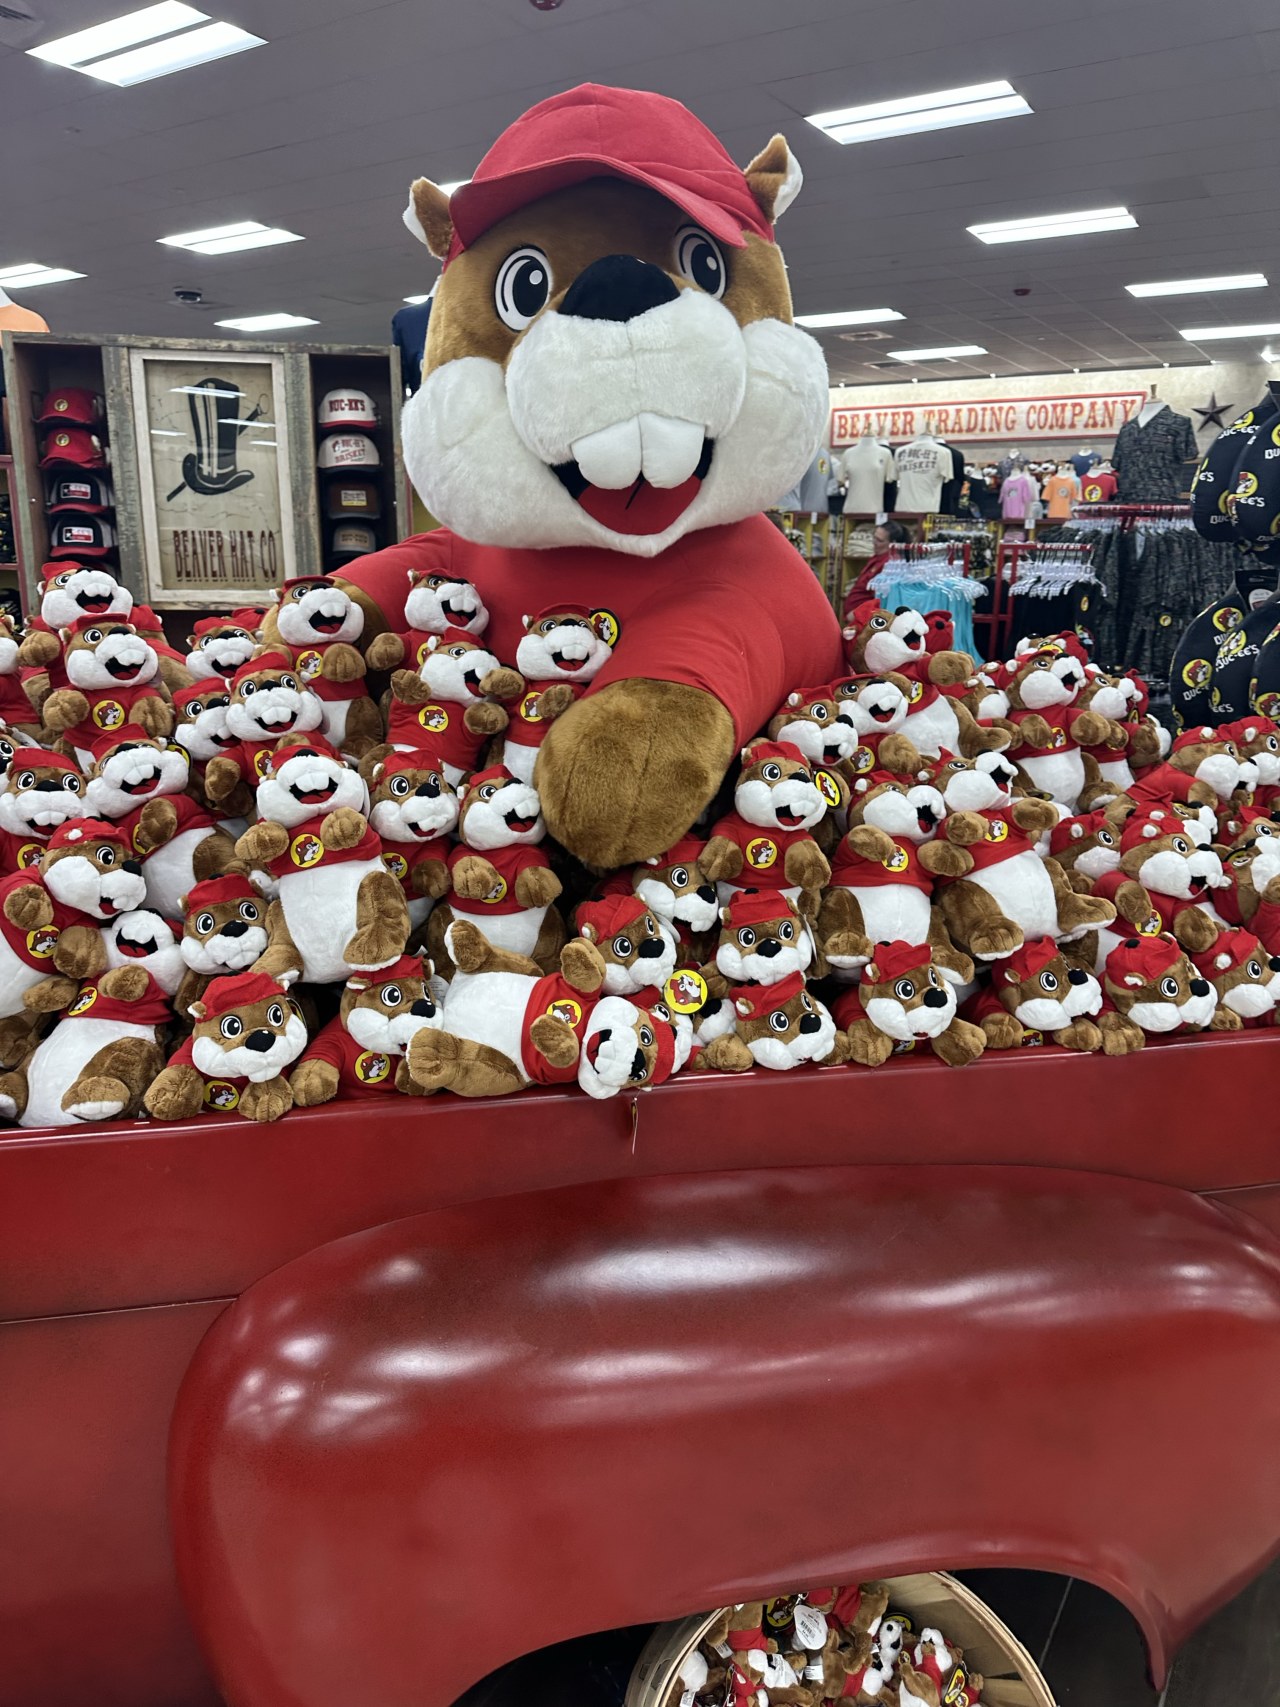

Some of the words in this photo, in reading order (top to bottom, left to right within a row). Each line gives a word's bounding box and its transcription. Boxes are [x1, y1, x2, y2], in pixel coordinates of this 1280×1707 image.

[836, 410, 915, 439] BEAVER
[923, 404, 1018, 434] TRADING
[1026, 399, 1137, 430] COMPANY
[1236, 496, 1265, 508] -EE'S
[173, 530, 228, 581] BEAVER
[229, 530, 256, 581] HAT
[260, 530, 277, 581] CO
